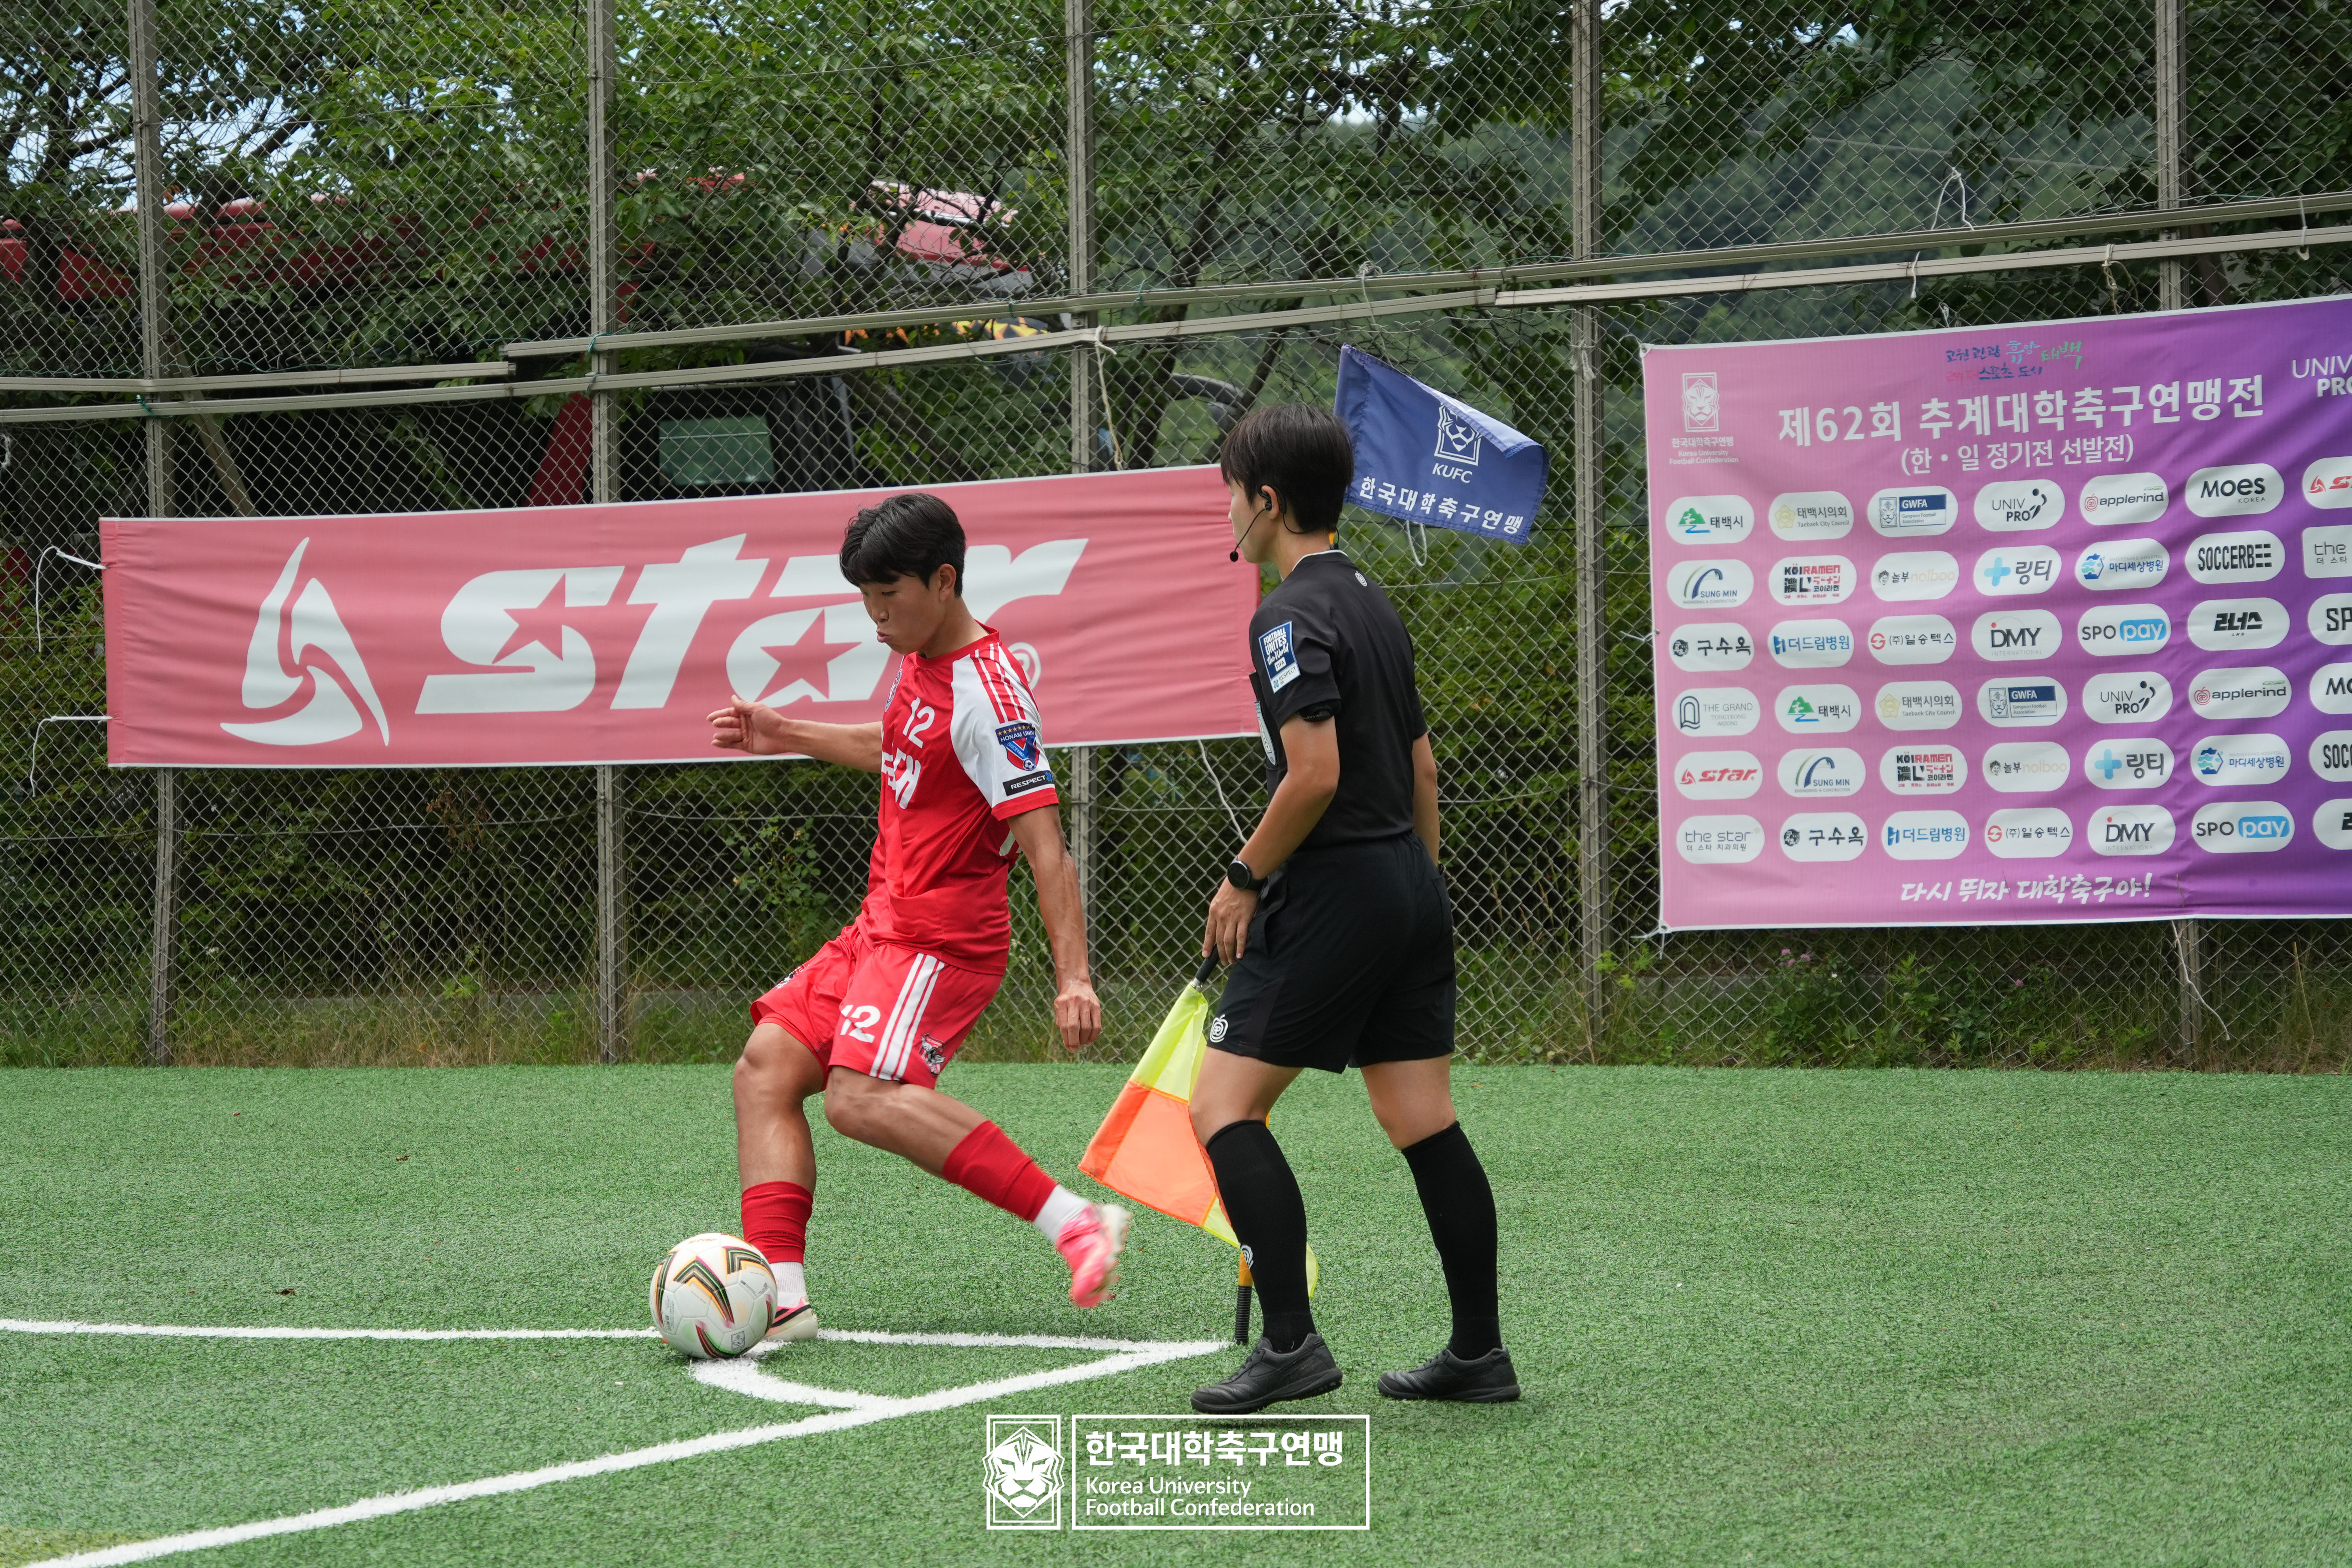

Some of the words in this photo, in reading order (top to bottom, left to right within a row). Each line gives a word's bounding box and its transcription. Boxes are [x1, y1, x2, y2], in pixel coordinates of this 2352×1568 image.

[2041, 341, 2082, 369] 태백
[1779, 401, 1901, 447] 제62회
[1919, 374, 2264, 440] 추계대학축구연맹전
[1671, 436, 1734, 448] 한국대학축구연맹
[1987, 438, 2053, 469] 정기전
[2061, 434, 2134, 464] 선발전)
[1432, 463, 1473, 483] KUFC
[1360, 476, 1524, 534] 한국대학축구연맹
[1902, 499, 1928, 509] GWFA
[1992, 499, 2025, 511] UNIV
[2100, 492, 2164, 507] applerind
[1798, 506, 1847, 519] 태백시의회
[2006, 511, 2030, 522] PRO
[1710, 516, 1743, 530] 태백시
[2315, 542, 2346, 555] the
[2016, 560, 2052, 585] 링티
[2110, 560, 2163, 573] 마디세상병원
[1892, 572, 1909, 583] 놀부
[1911, 569, 1956, 582] nolboo
[1263, 627, 1286, 645] FOOTBALL
[1991, 627, 2042, 648] DMY
[1265, 634, 1287, 655] UNITES
[1698, 636, 1751, 656] 구수옥
[1789, 636, 1850, 651] 더드림병원
[1267, 655, 1275, 666] the
[1274, 643, 1289, 660] World
[1279, 666, 1296, 681] RESPECT
[2012, 690, 2037, 699] GWFA
[2101, 690, 2133, 702] UNIV
[2212, 686, 2286, 700] applerind
[1902, 695, 1954, 708] 태백시의회
[2116, 703, 2139, 714] PRO
[1819, 705, 1851, 719] 태백시
[902, 696, 935, 749] 12
[1000, 732, 1022, 742] HONAM
[2004, 762, 2021, 773] 놀부
[2023, 759, 2067, 773] nolboo
[2127, 753, 2164, 779] 링티
[2229, 757, 2284, 769] 마디세상병원
[1011, 775, 1046, 789] RESPECT
[1686, 830, 1712, 842] the
[1717, 830, 1752, 842] star
[1809, 827, 1864, 846] 구수옥
[1903, 827, 1965, 843] 더드림병원
[2106, 823, 2155, 842] DMY
[1901, 881, 1953, 902] 다시
[1959, 879, 2011, 902] 뛰자
[2017, 873, 2153, 904] 대학축구야!
[840, 1005, 881, 1043] 12
